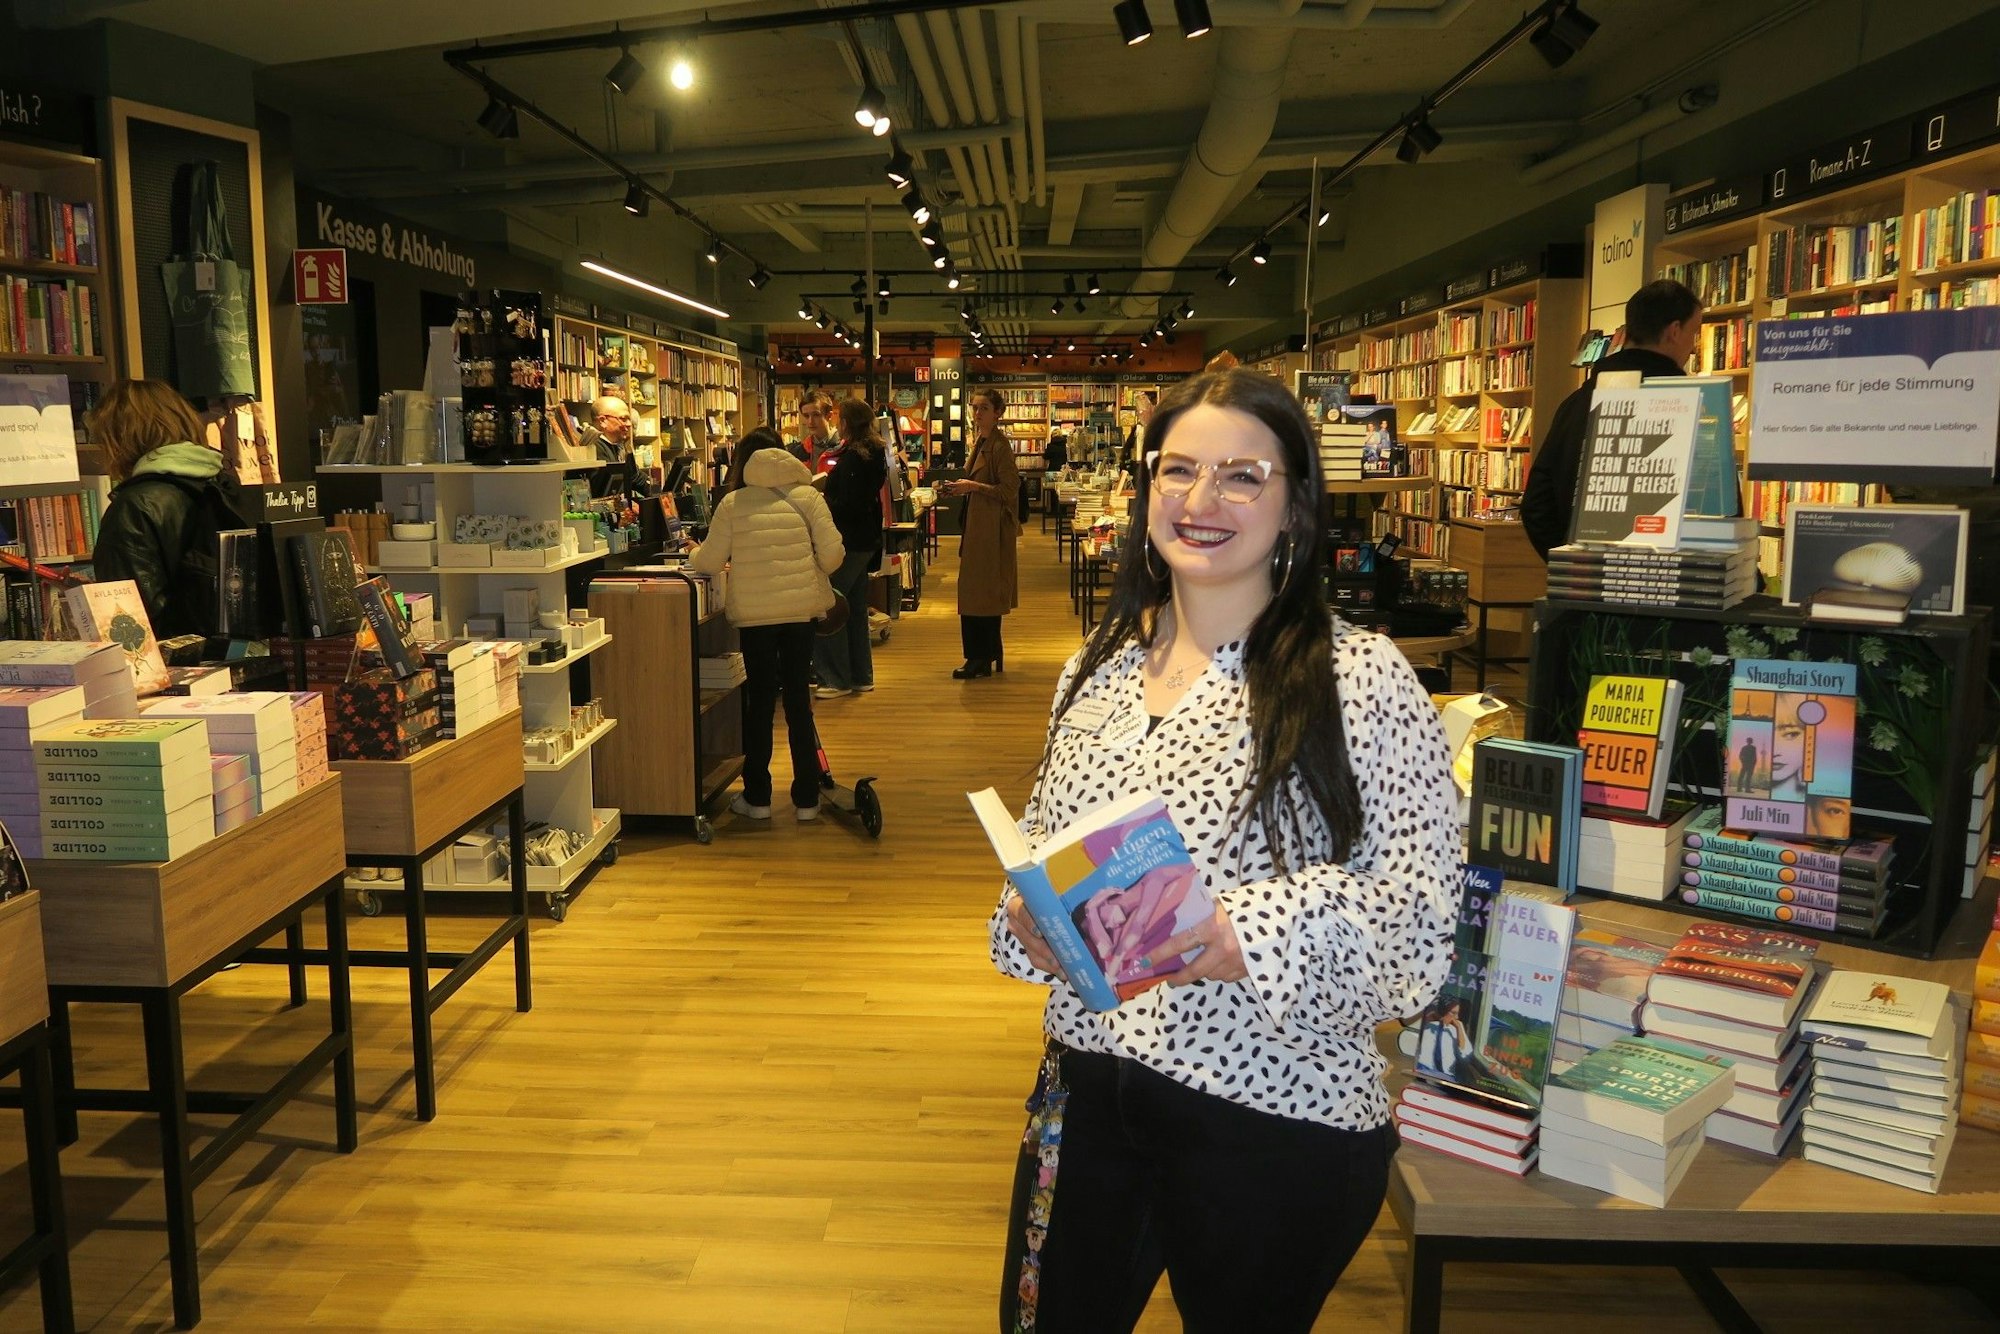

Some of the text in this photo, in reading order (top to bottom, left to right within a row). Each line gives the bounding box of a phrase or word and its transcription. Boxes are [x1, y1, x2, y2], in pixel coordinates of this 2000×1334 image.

[1810, 159, 1843, 183] Romane
[317, 202, 475, 287] Kasse & Abholung
[1602, 237, 1633, 264] tolino
[1763, 325, 1852, 340] Von uns für Sie
[934, 368, 960, 381] Info
[1773, 377, 1975, 395] Romane für jede Stimmung
[1597, 418, 1623, 435] VON
[1763, 424, 1780, 432] Hier
[1781, 424, 1807, 432] finden
[1809, 424, 1823, 432] Sie
[1826, 424, 1842, 432] alte
[1844, 424, 1886, 432] Bekannte
[1888, 423, 1906, 431] und
[1594, 438, 1643, 455] DIE WIR
[1590, 457, 1623, 474] GERN
[1587, 475, 1629, 493] SCHON
[265, 490, 305, 513] Thalia Tipp
[1584, 492, 1629, 513] HÄTTEN
[1746, 666, 1846, 693] Shanghai Story
[1605, 683, 1645, 703] MARIA
[1590, 704, 1655, 727] POURCHET
[44, 748, 98, 759] COLLIDE
[1584, 742, 1648, 776] FEUER
[47, 772, 101, 782] COLLIDE
[1486, 757, 1554, 794] BELA B
[50, 795, 103, 806] COLLIDE
[51, 819, 105, 830] COLLIDE
[1740, 804, 1791, 825] Juli Min
[1111, 826, 1172, 861] Lügen,
[1481, 803, 1553, 865] FUN
[53, 843, 107, 853] COLLIDE
[1106, 840, 1170, 878] die wir uns
[1706, 837, 1837, 871] Shanghai Story Juli Min
[1125, 849, 1175, 880] erzählen
[1704, 854, 1836, 889] Shanghai Story Juli Min
[1463, 870, 1492, 890] Neu
[1703, 874, 1834, 908] Shanghai Story Juli Min
[1470, 896, 1538, 923] DANIEL
[1702, 893, 1833, 928] Shanghai Story Juli Min
[1459, 910, 1559, 944] LATTAUER
[1687, 927, 1749, 942] WAS
[1763, 937, 1816, 956] DIE
[1671, 944, 1803, 973] GEZEITEN
[1467, 963, 1526, 987] DANIEL
[1659, 961, 1795, 991] VERBERGEN
[1447, 972, 1543, 1007] GLATTAUER
[1502, 1034, 1520, 1050] IN
[1815, 1035, 1849, 1048] Neu
[1606, 1065, 1689, 1091] SPÜRST
[1661, 1071, 1699, 1086] DIE
[1602, 1080, 1674, 1102] NICHT
